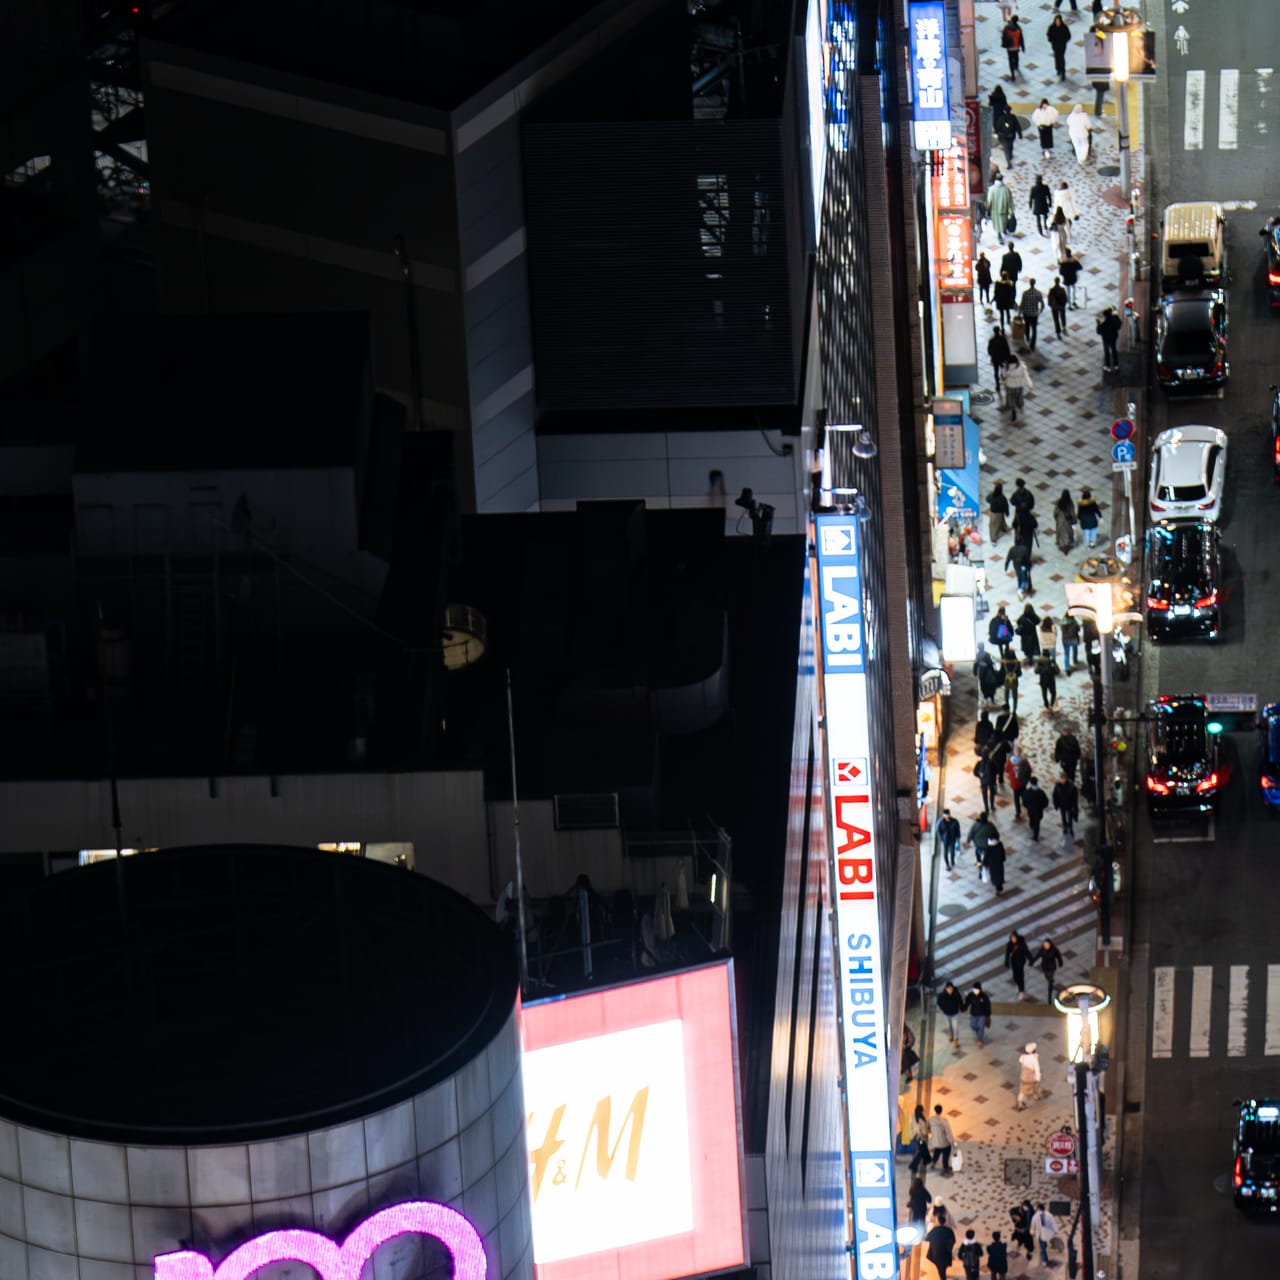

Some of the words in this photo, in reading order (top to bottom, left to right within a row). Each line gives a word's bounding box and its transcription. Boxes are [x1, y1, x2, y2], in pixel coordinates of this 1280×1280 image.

[824, 565, 862, 667] LABI
[835, 794, 874, 900] LABI
[847, 932, 878, 1070] SHIBUYA
